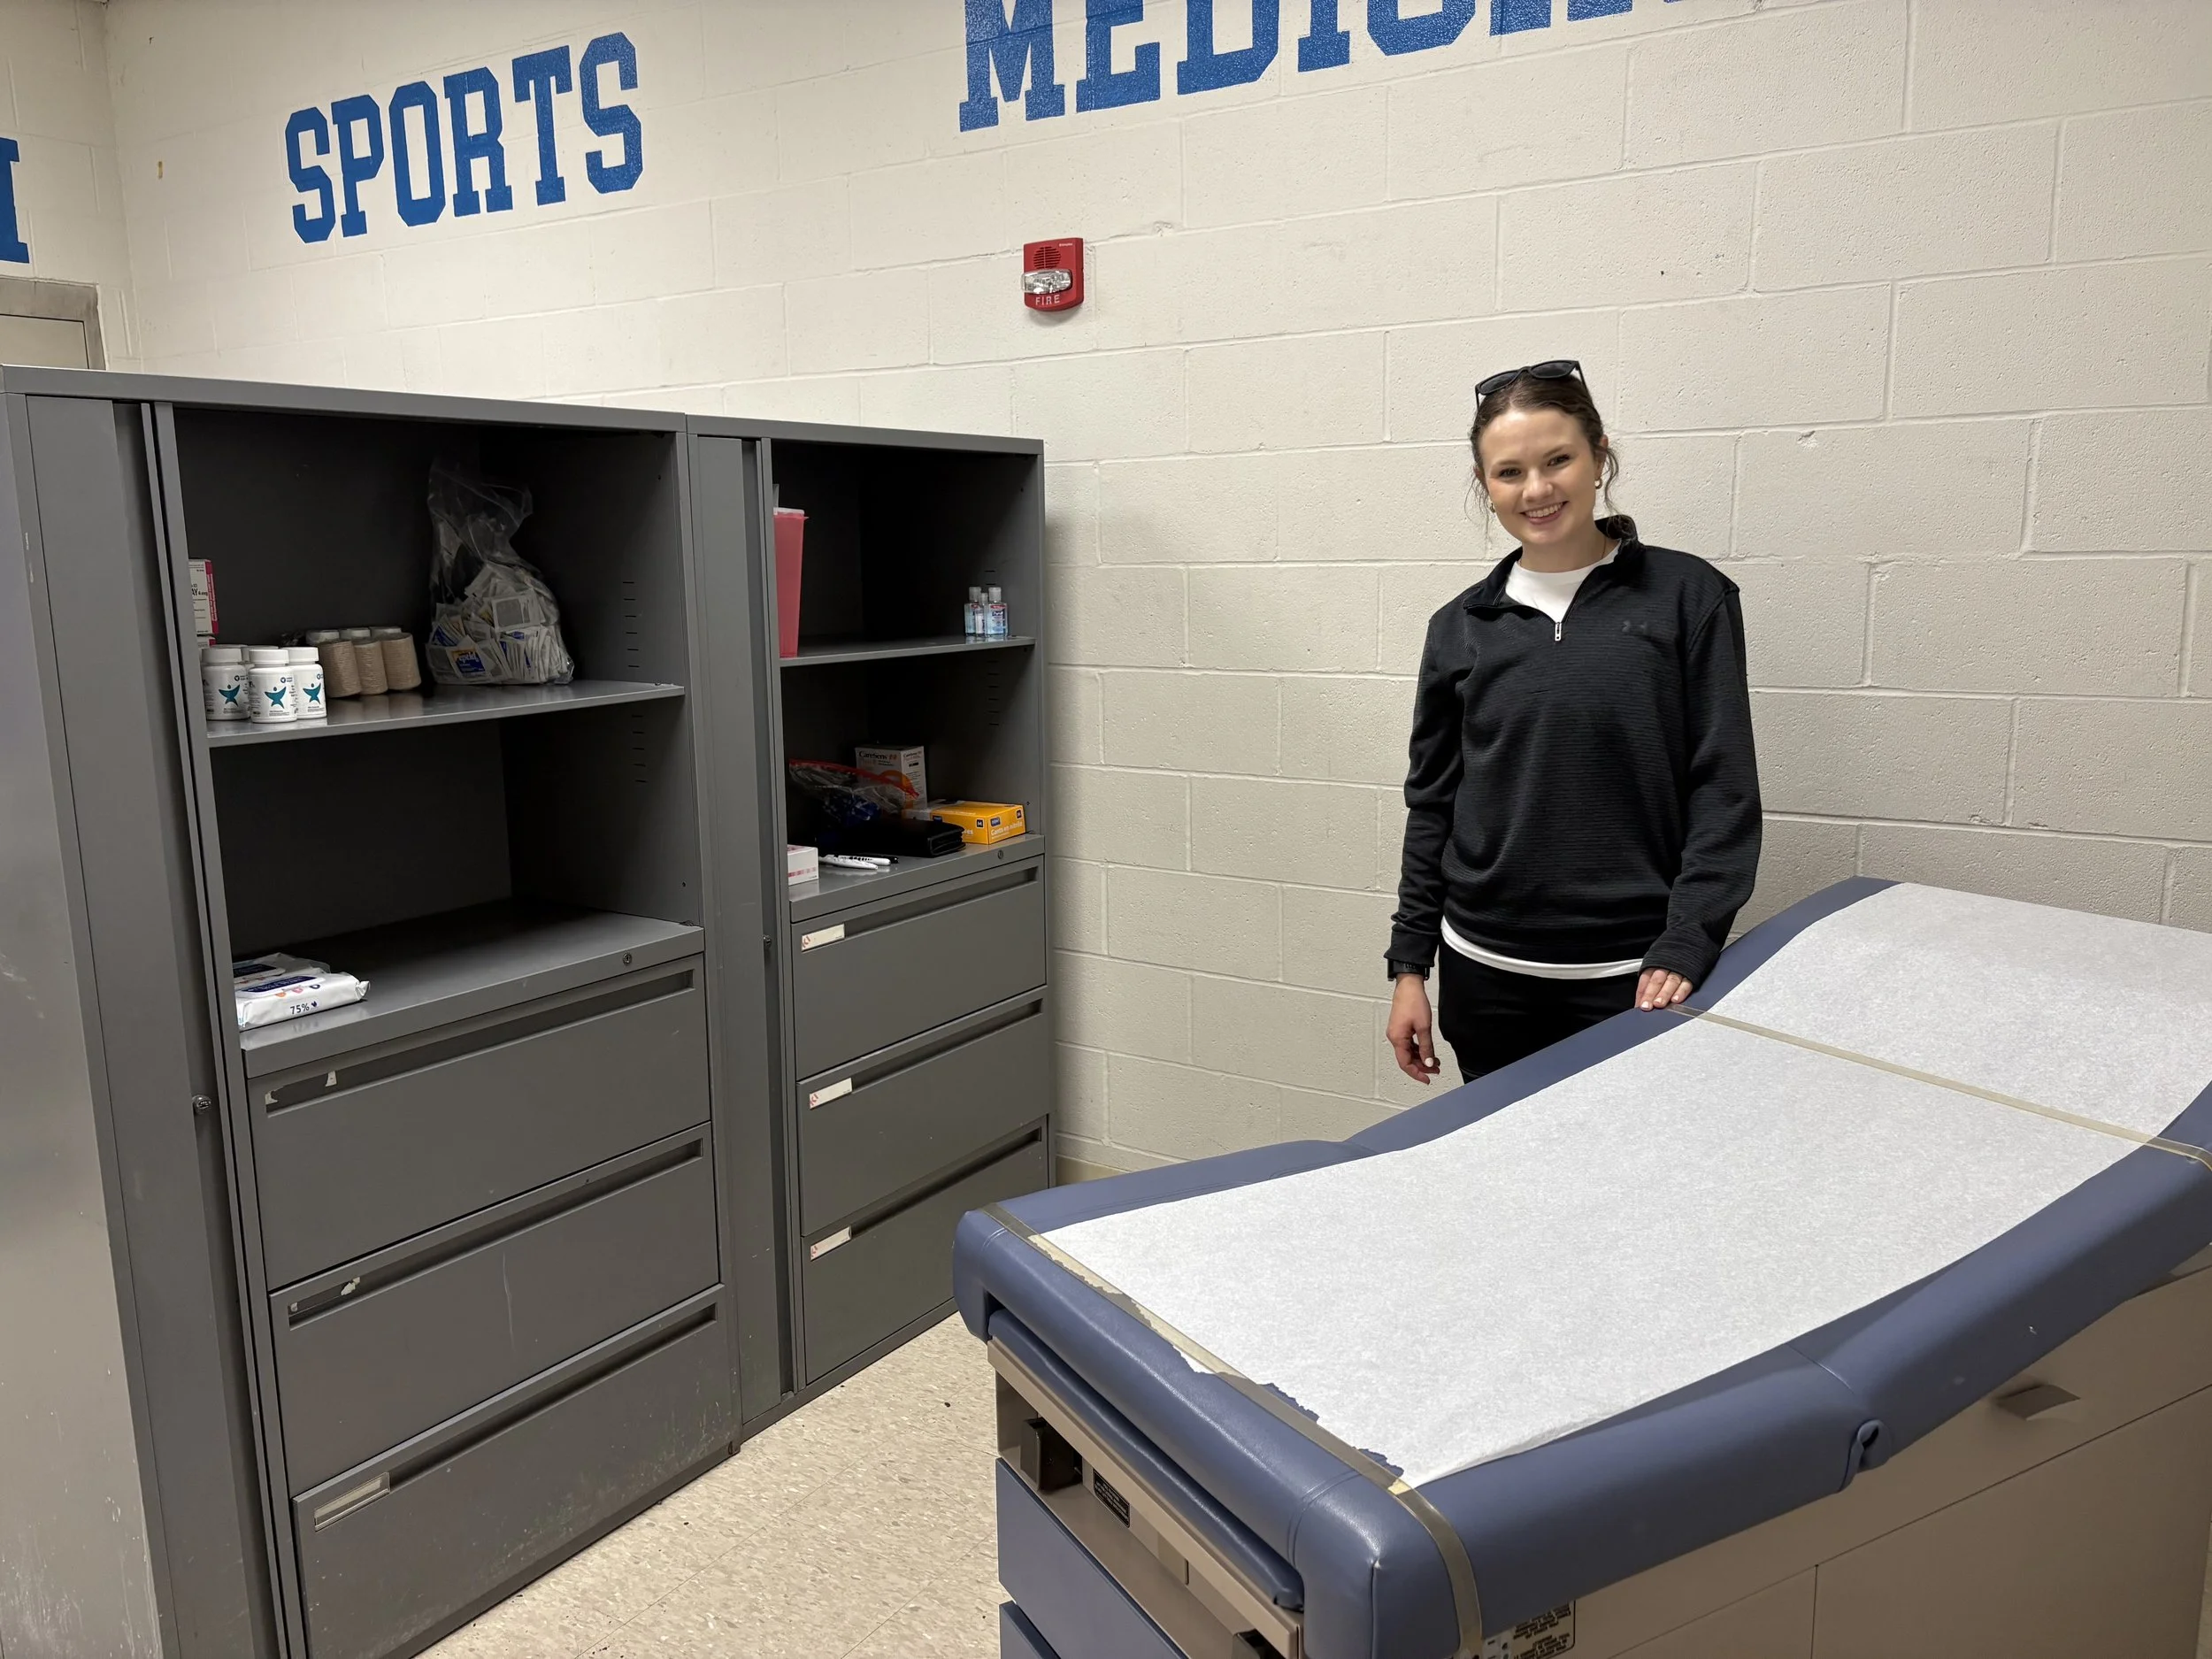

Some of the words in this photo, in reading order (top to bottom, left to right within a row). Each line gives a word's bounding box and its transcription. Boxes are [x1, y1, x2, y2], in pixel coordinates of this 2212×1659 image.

[285, 32, 644, 243] SPORTS
[1036, 295, 1060, 305] FIRE
[859, 750, 887, 760] CareSens
[290, 1002, 310, 1015] 75%
